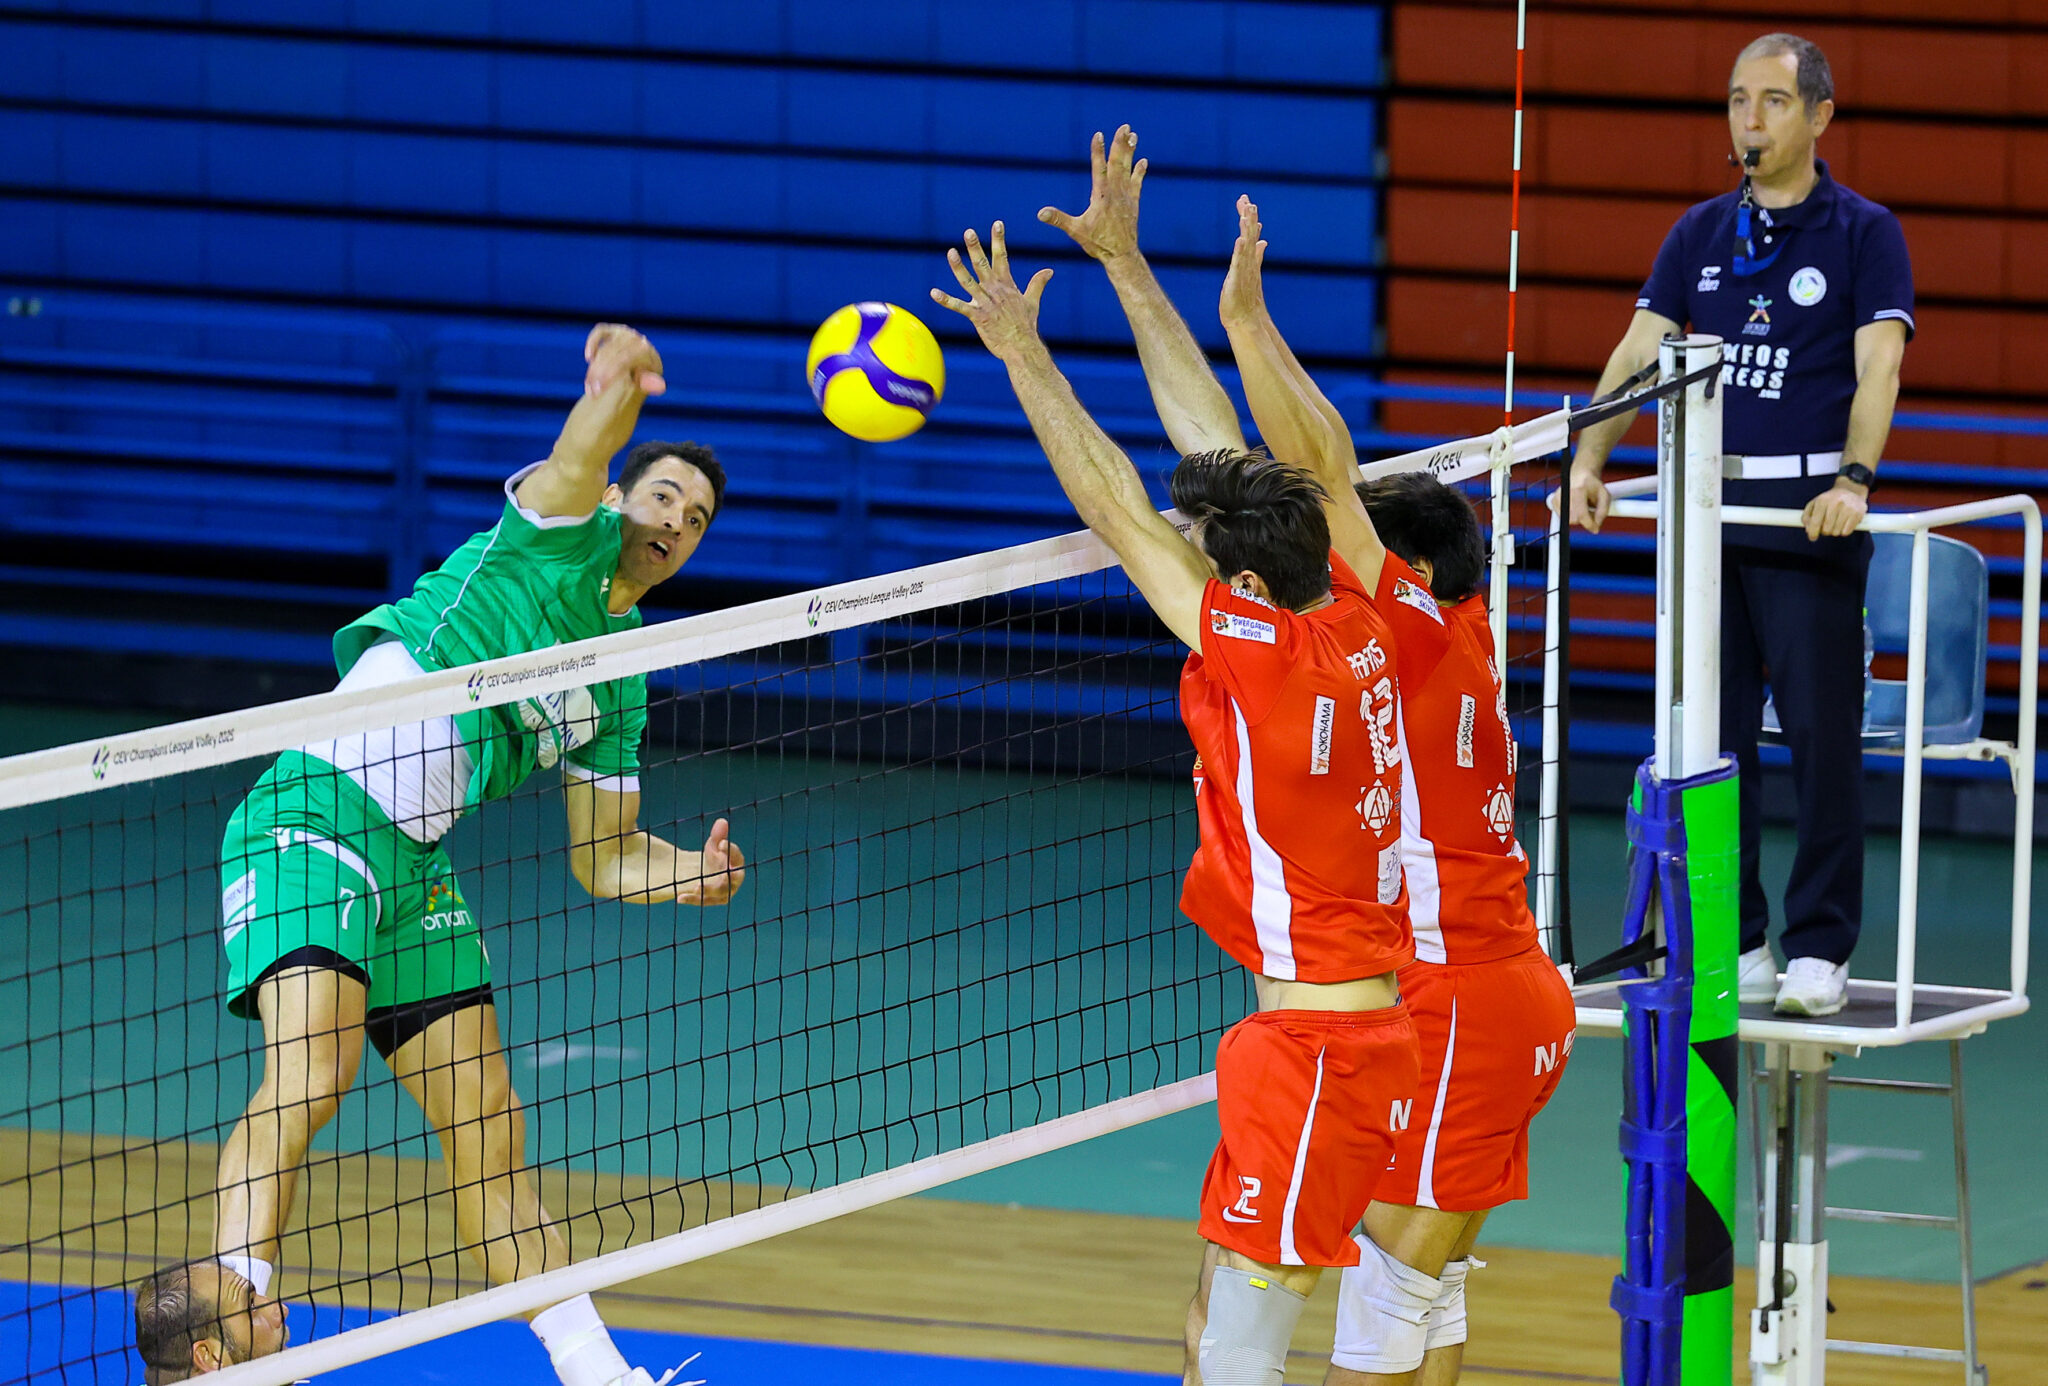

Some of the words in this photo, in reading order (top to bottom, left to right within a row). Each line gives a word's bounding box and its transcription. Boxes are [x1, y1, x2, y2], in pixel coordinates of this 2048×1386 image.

[1721, 364, 1785, 389] RESS
[1441, 450, 1463, 471] CEV
[824, 600, 838, 613] CEV
[838, 595, 870, 611] Champions
[870, 590, 891, 604] League
[892, 585, 910, 599] Volley
[909, 581, 924, 595] 2025
[487, 674, 501, 688] CEV
[501, 668, 536, 685] Champions
[537, 663, 559, 680] League
[561, 658, 580, 672] Volley
[580, 653, 597, 668] 2025
[113, 750, 128, 765] CEV
[129, 744, 168, 762] Champions
[169, 740, 194, 755] League
[196, 733, 217, 749] Volley
[218, 728, 235, 744] 2025
[1318, 702, 1332, 756] YOKOHAMA
[339, 887, 357, 930] 7
